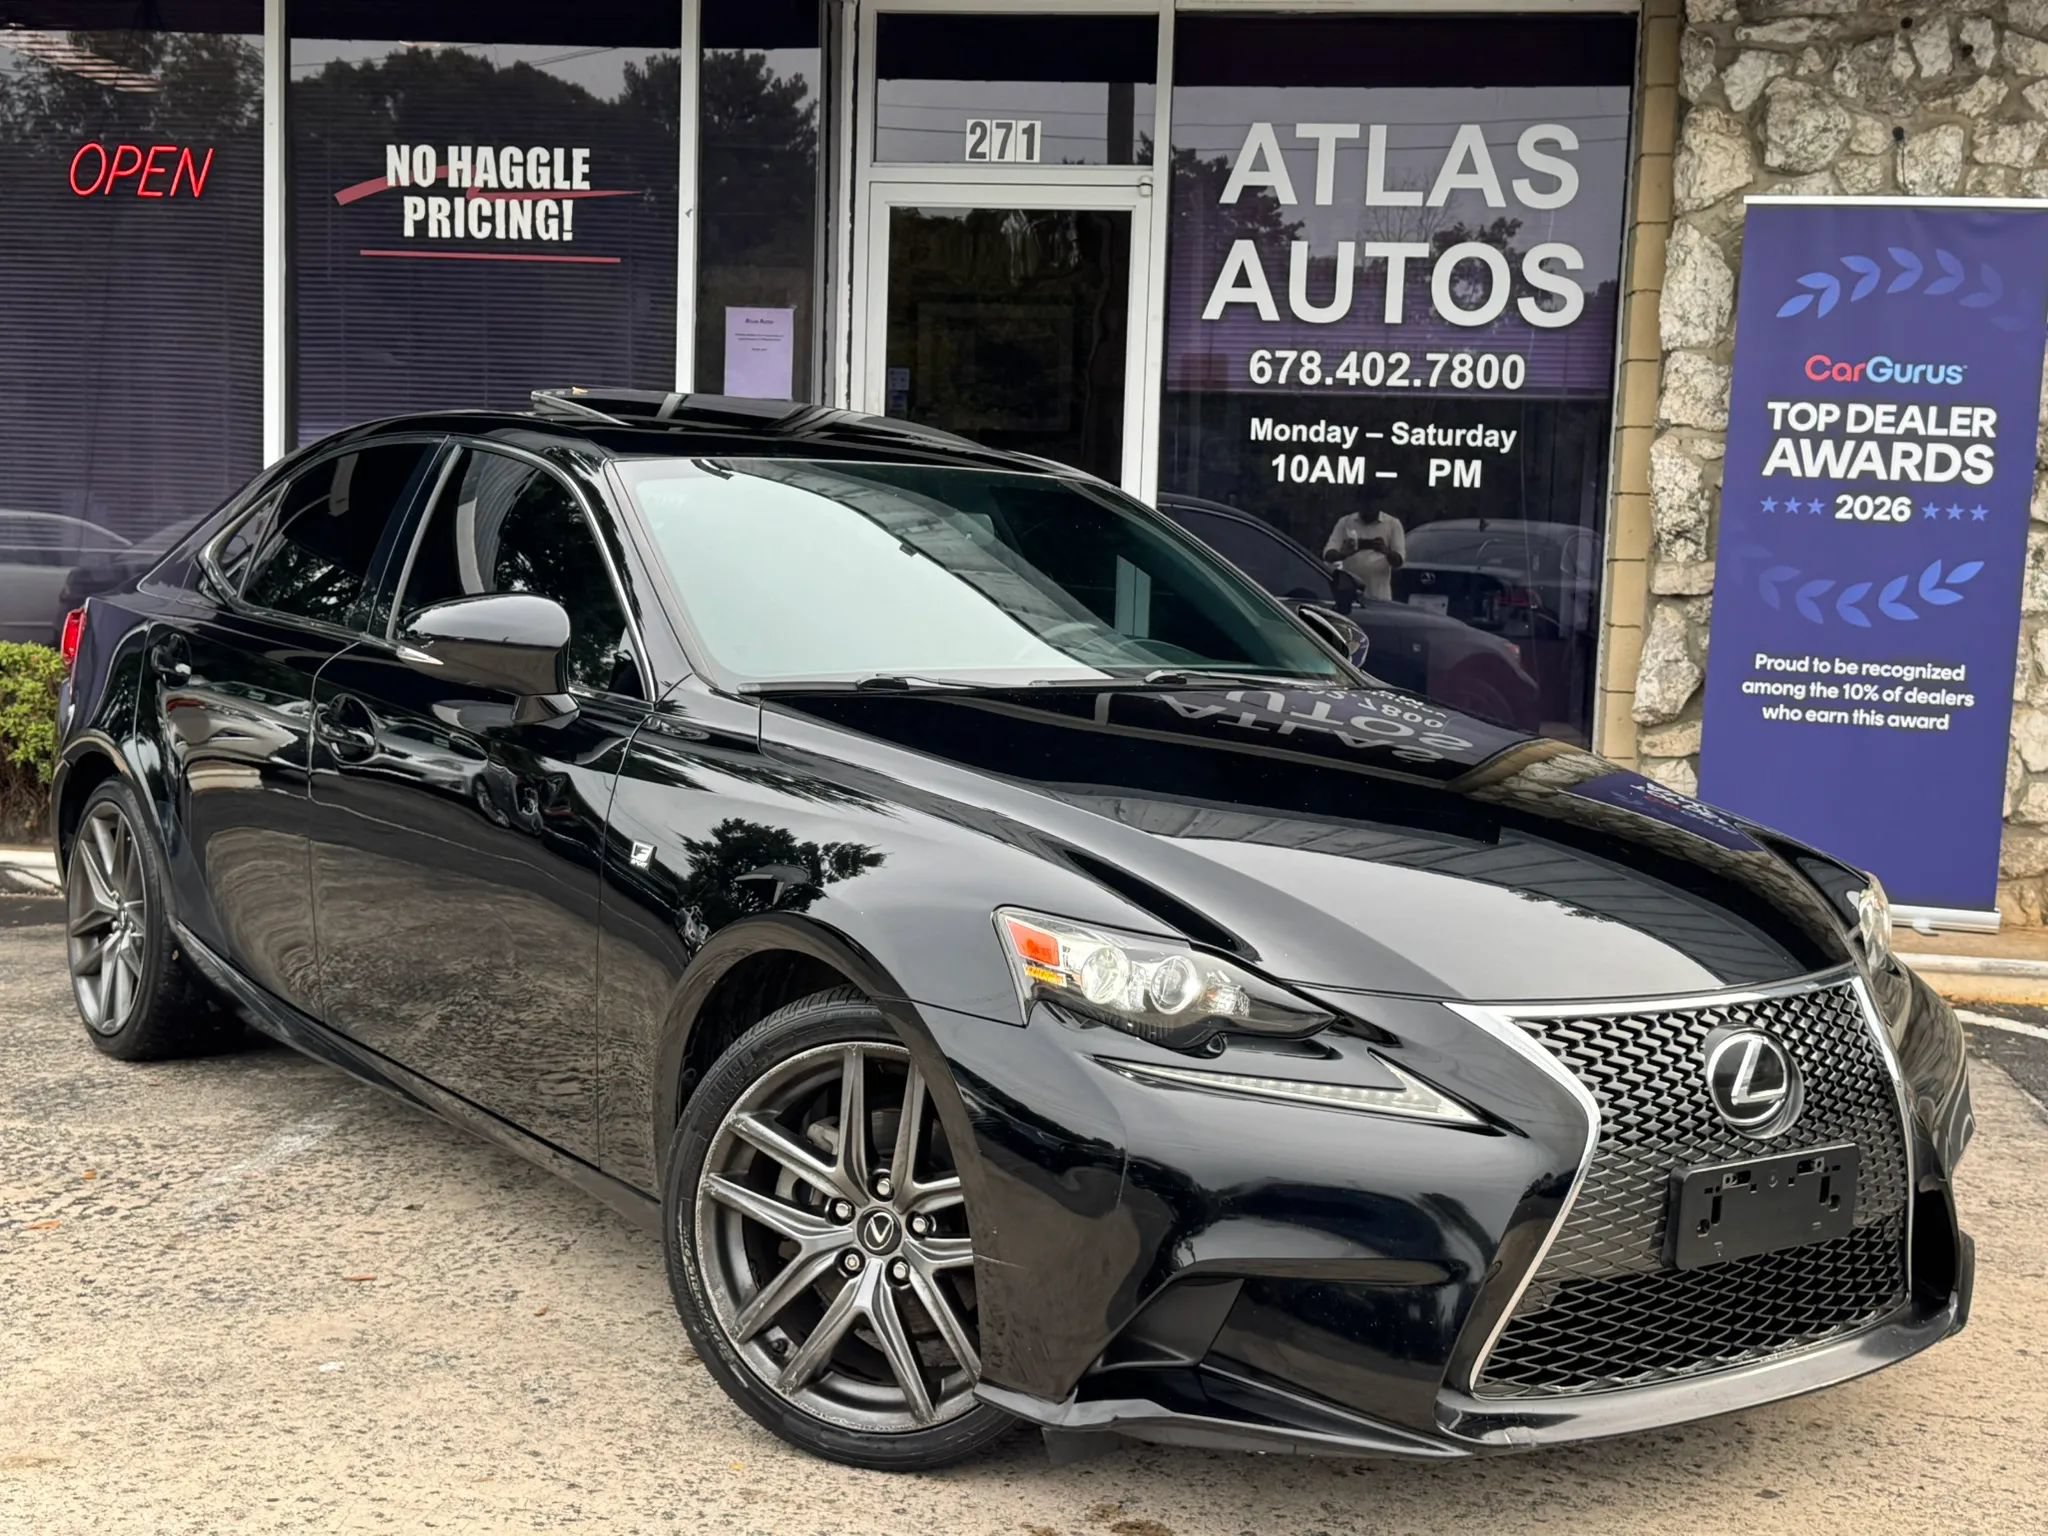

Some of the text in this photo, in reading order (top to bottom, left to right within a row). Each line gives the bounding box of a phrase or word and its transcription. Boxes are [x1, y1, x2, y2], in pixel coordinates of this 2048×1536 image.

[968, 120, 1036, 161] 271
[69, 142, 213, 198] OPEN
[386, 144, 591, 190] NO HAGGLE
[1219, 122, 1580, 209] ATLAS
[403, 196, 573, 241] PRICING!
[1202, 239, 1585, 328] AUTOS
[1249, 349, 1526, 390] 678.402.7800
[1805, 354, 1964, 386] CarGurus
[1250, 417, 1359, 450] Monday
[1391, 421, 1518, 454] Saturday
[1767, 401, 1997, 438] TOP DEALER
[1271, 453, 1366, 485] 10AM
[1428, 458, 1483, 488] PM
[1761, 437, 1995, 485] AWARDS
[1834, 494, 1912, 522] 2026
[1755, 653, 1966, 682] Proud to be recognized
[1741, 680, 1975, 708] among the 10% of dealers
[1761, 703, 1950, 731] who earn this award
